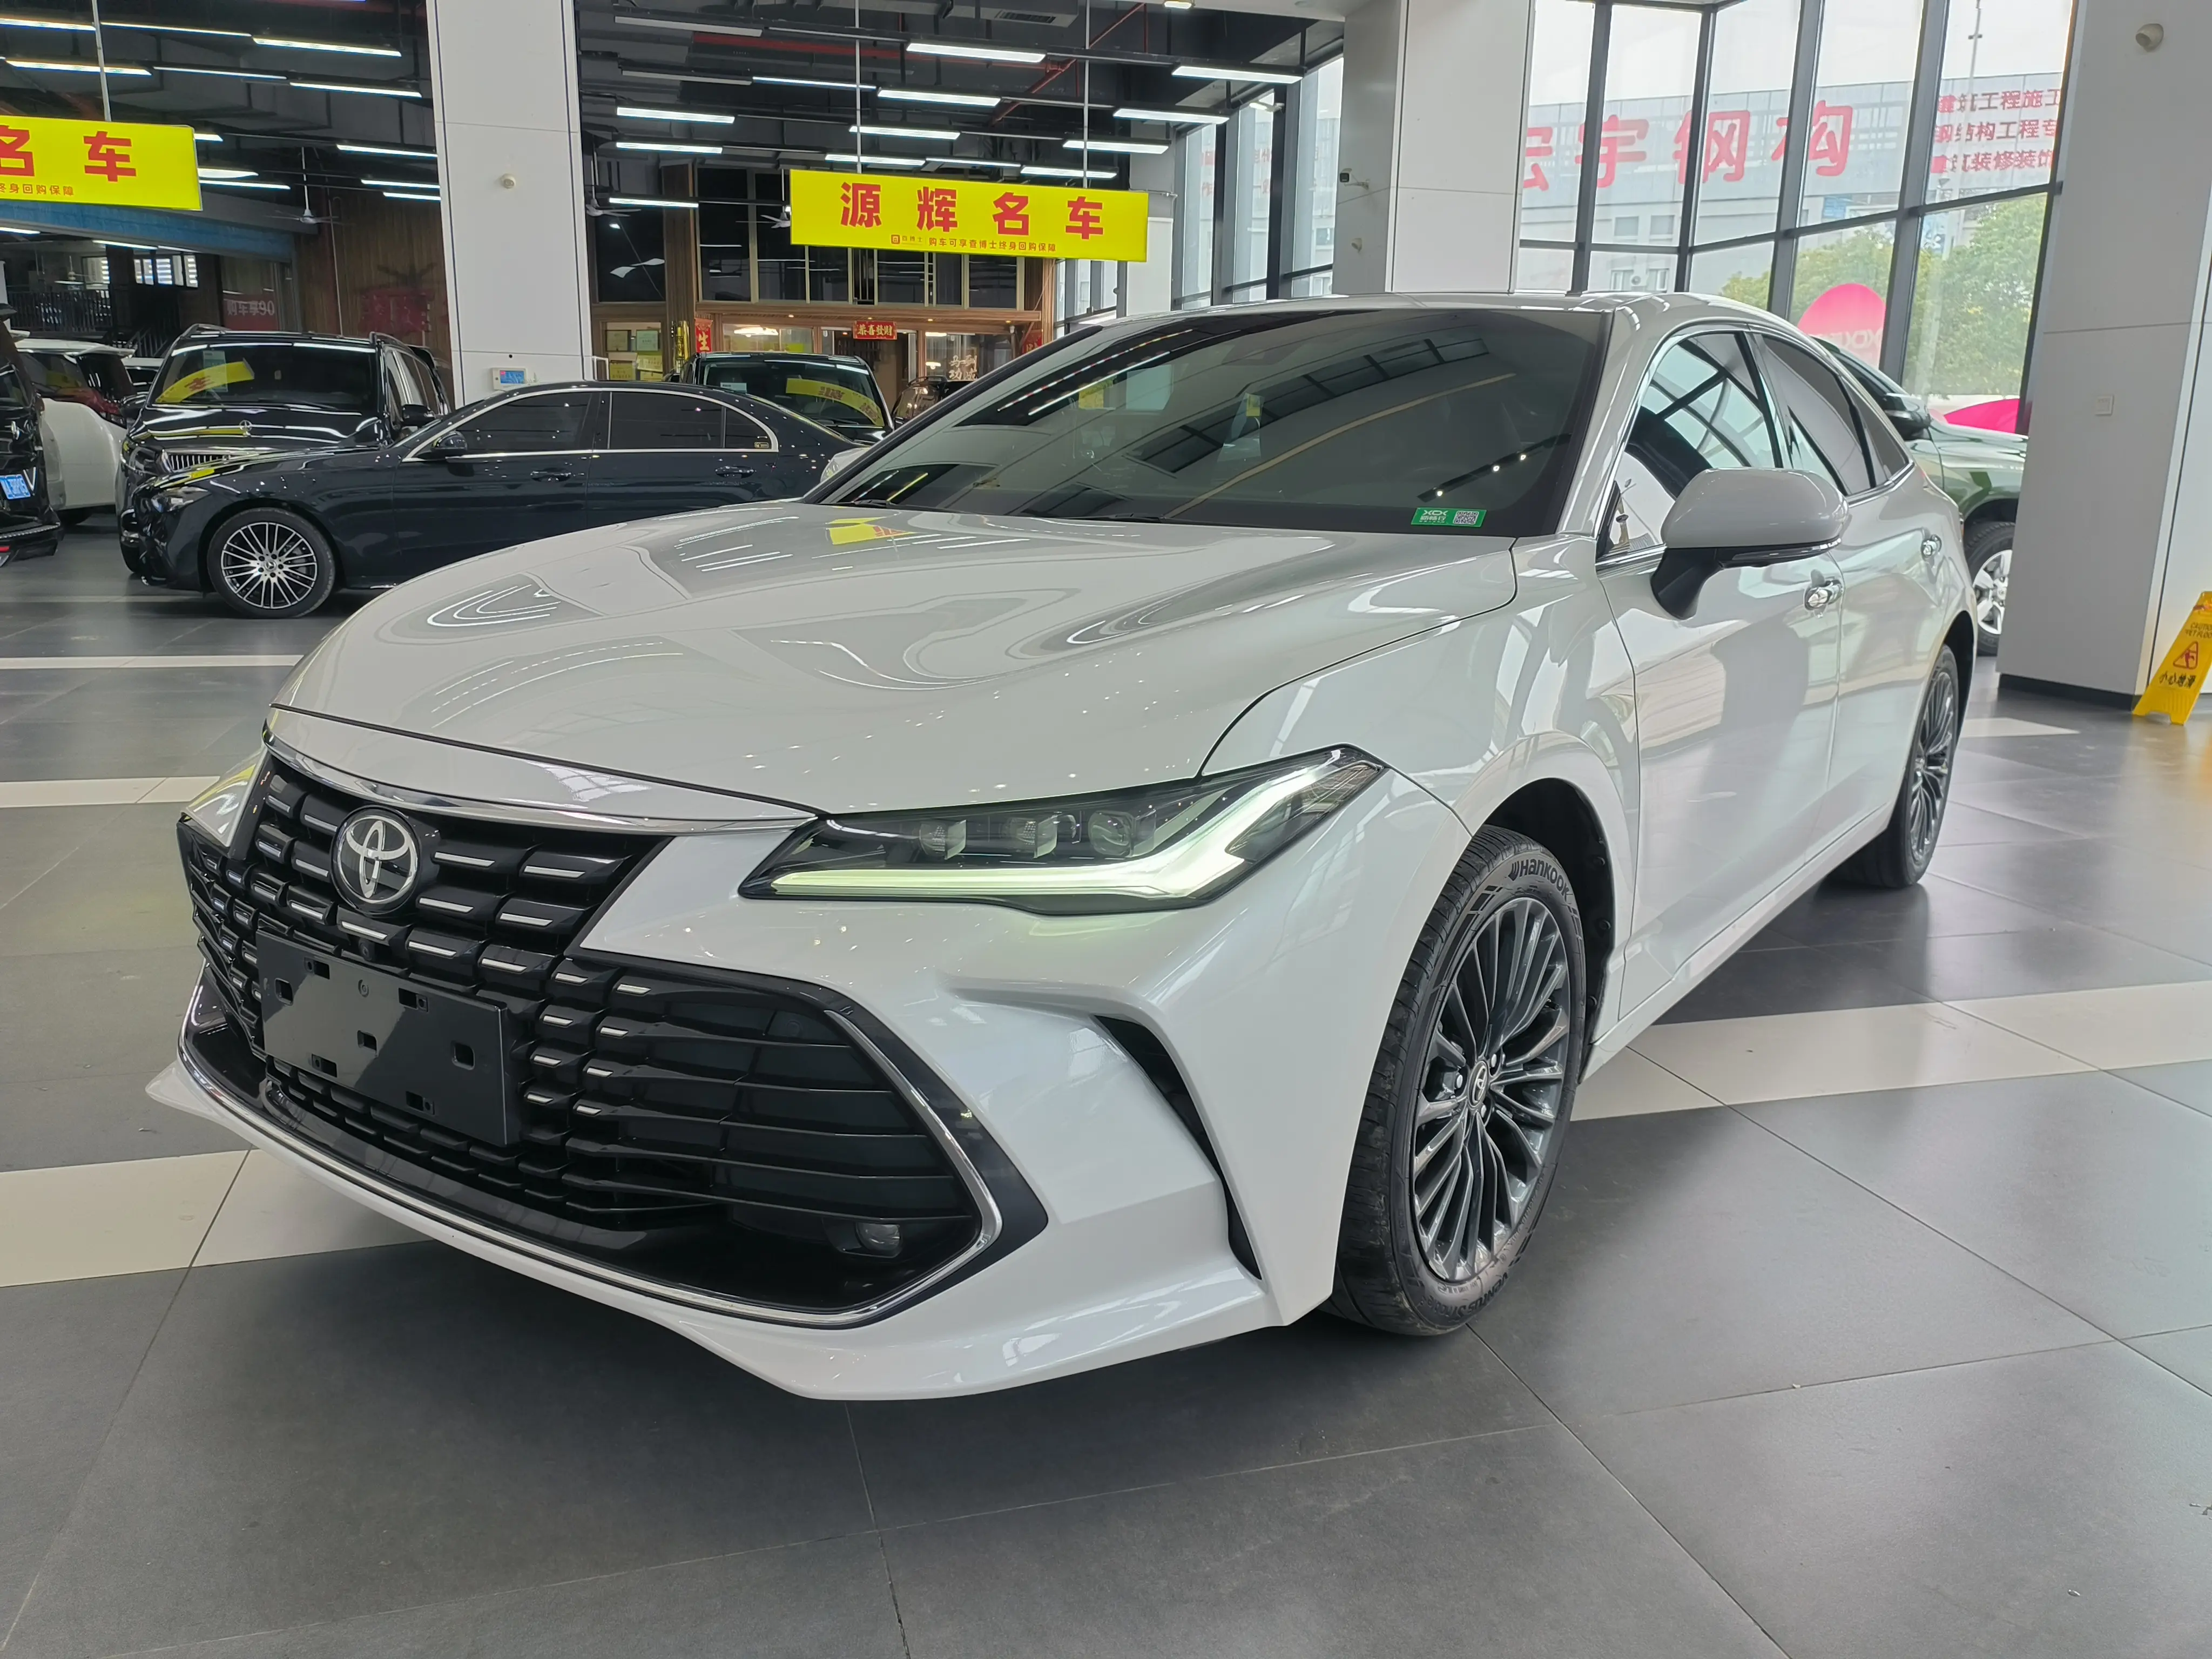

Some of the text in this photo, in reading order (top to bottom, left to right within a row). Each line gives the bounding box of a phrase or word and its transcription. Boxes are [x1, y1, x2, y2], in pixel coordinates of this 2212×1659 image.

[840, 181, 1104, 240] 源辉名车
[929, 237, 1056, 252] 购车可享查博士终身回购保障
[698, 331, 710, 351] 生
